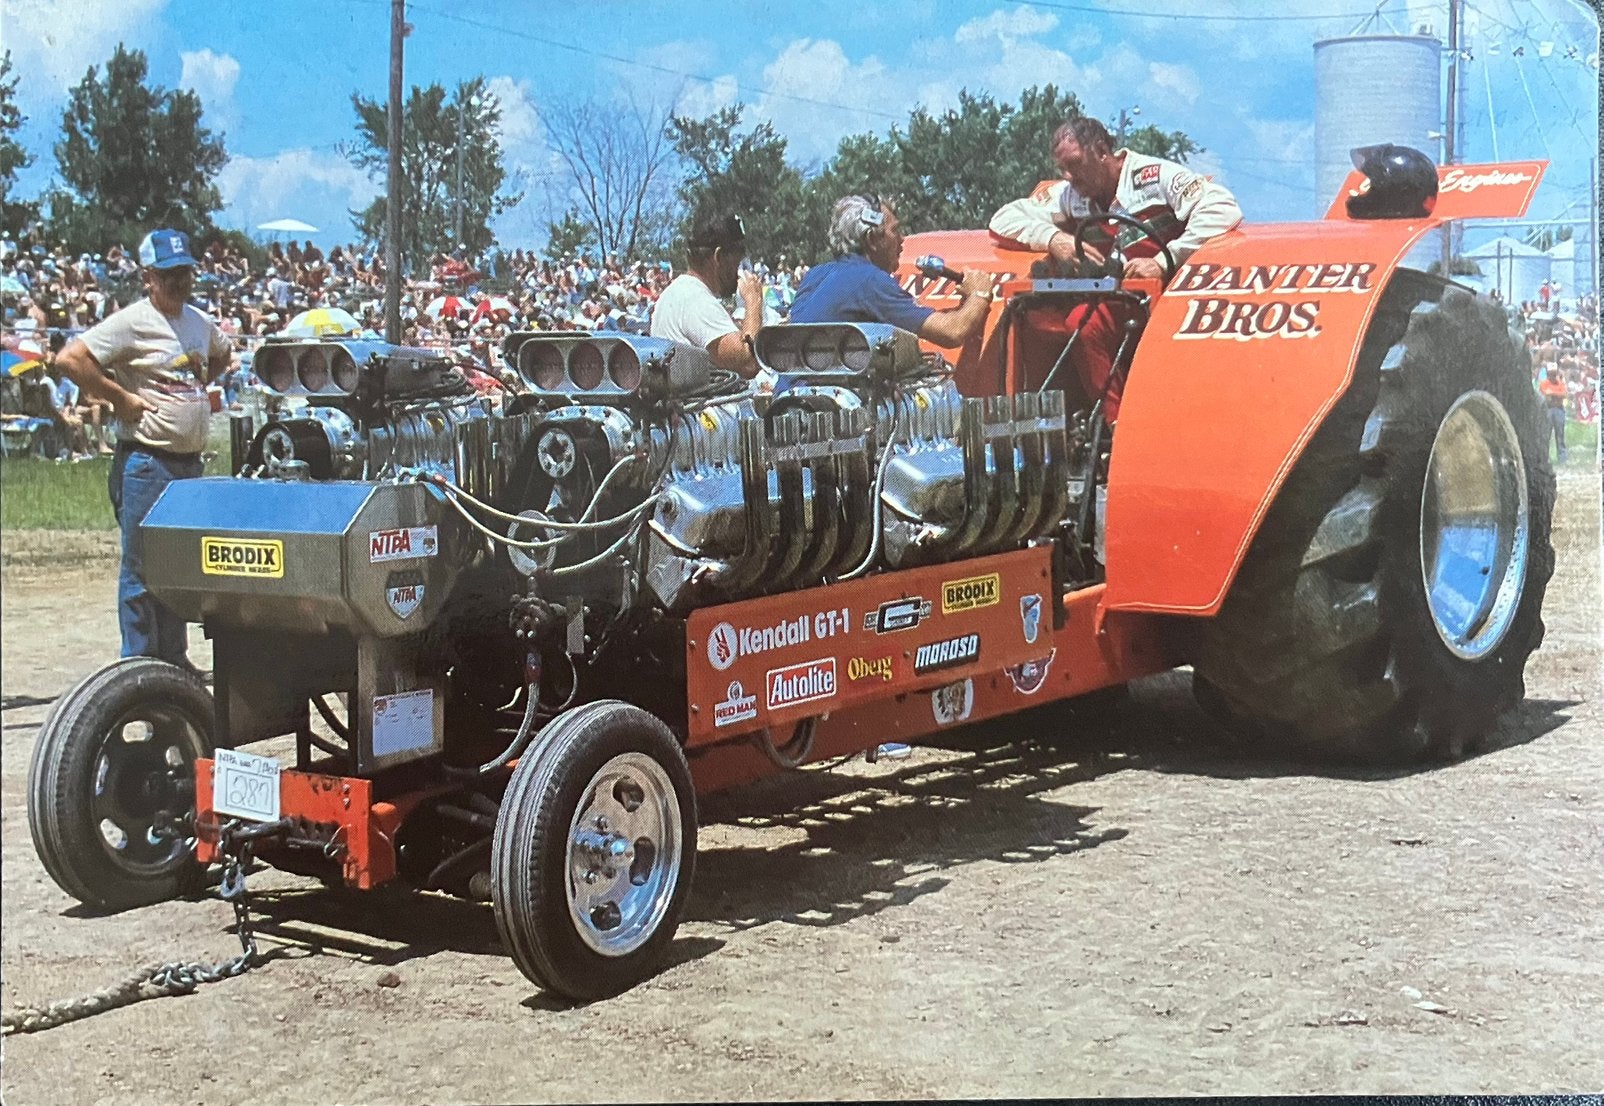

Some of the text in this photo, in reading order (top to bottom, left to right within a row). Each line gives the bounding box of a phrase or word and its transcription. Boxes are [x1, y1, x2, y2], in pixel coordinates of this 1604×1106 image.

[1438, 170, 1531, 193] Engines
[1165, 262, 1377, 295] BANTER
[1173, 298, 1322, 341] BROS.
[209, 544, 276, 566] BRODIX
[371, 528, 411, 557] NTPA
[946, 579, 995, 604] BRODIX
[740, 615, 810, 656] Kendall
[814, 607, 850, 639] GT-1
[914, 634, 979, 669] MOROSO
[847, 656, 893, 682] Oberg
[770, 666, 833, 704] Autolite
